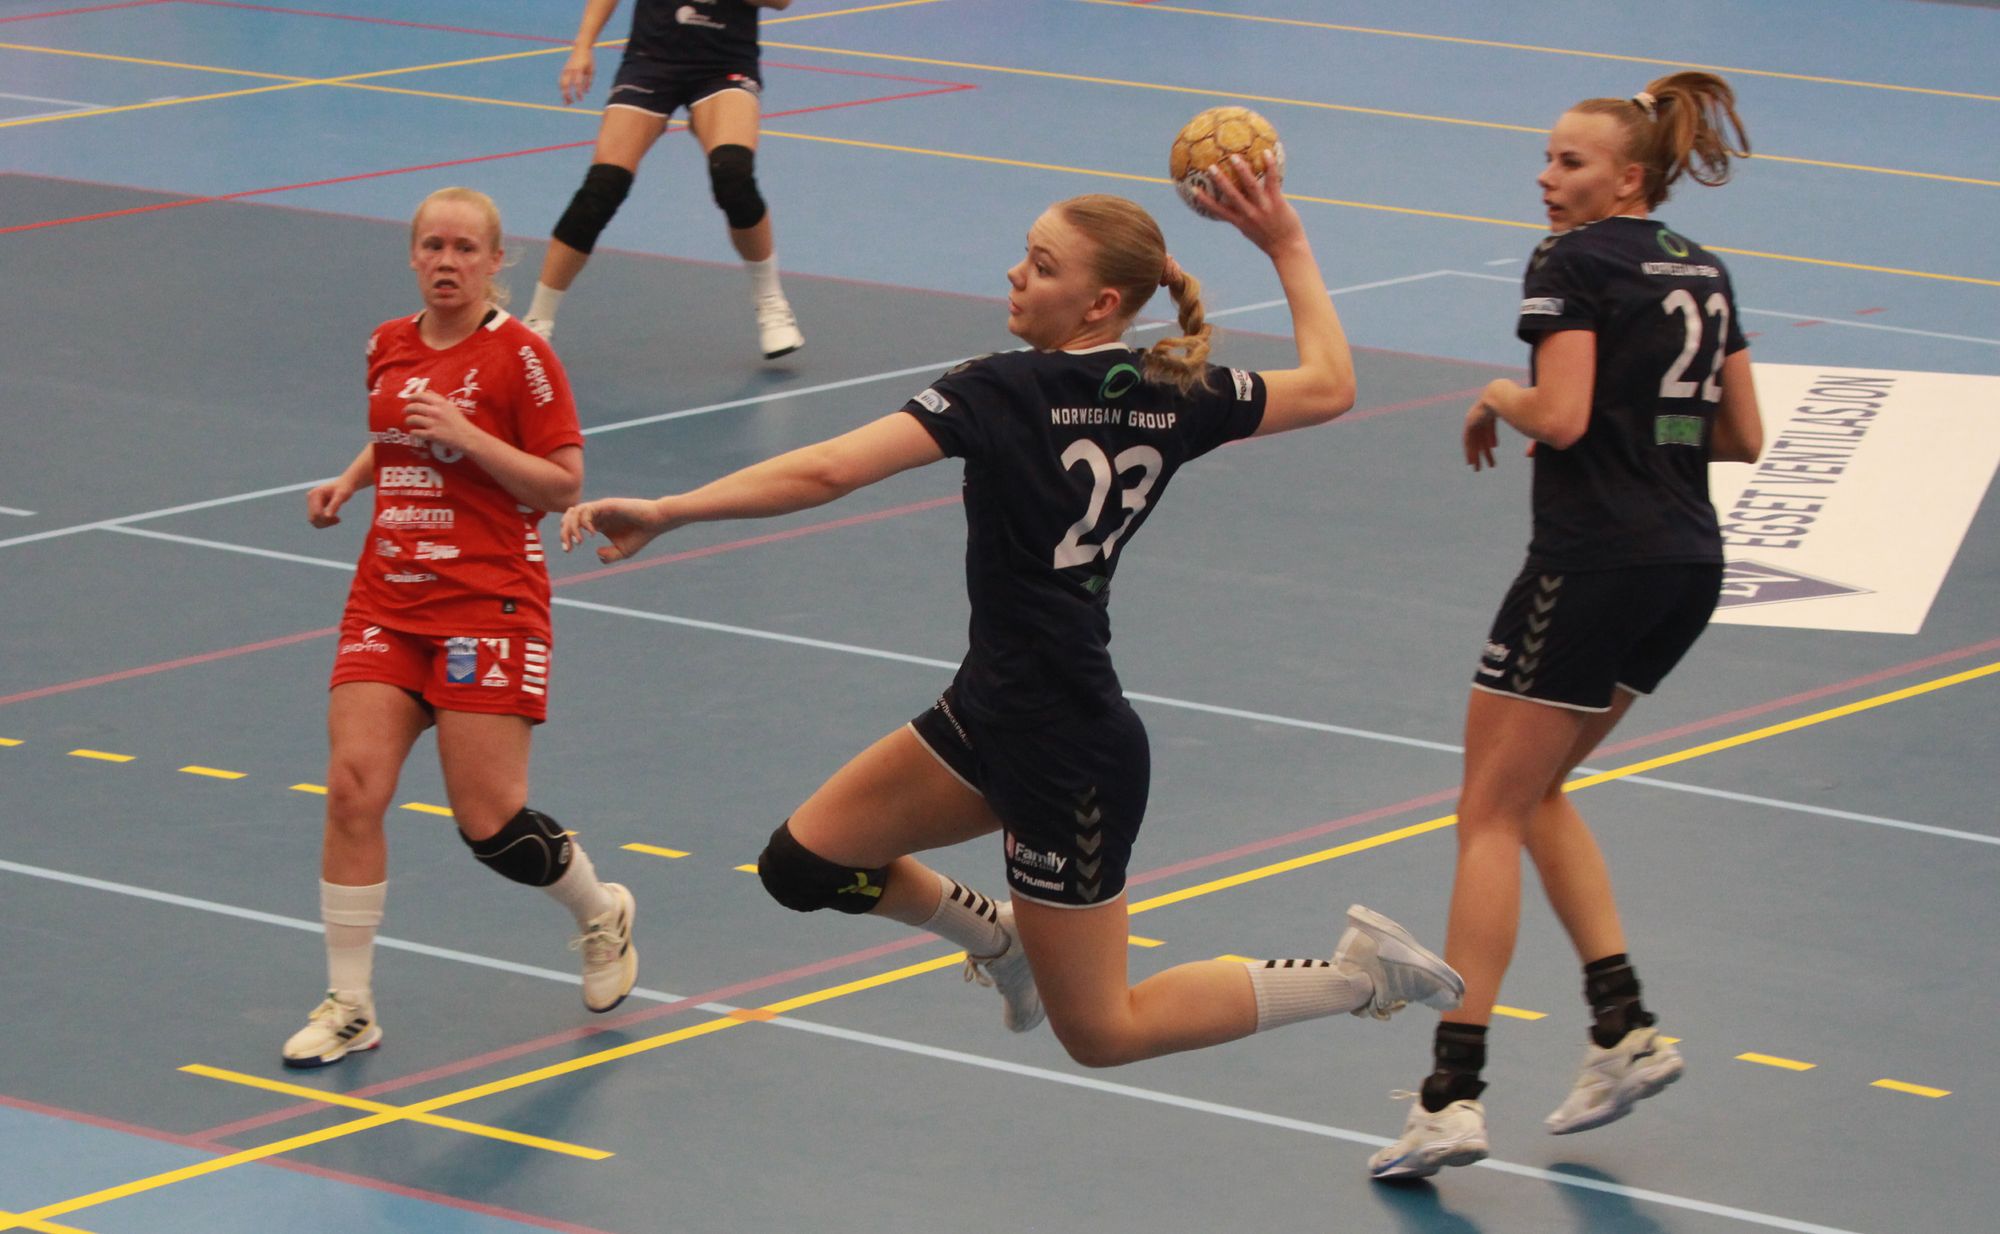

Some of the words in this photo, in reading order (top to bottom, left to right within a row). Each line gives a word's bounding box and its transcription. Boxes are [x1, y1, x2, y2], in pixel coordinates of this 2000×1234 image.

[1657, 289, 1730, 404] 22
[1051, 407, 1122, 425] NORWEGAN
[1128, 410, 1177, 430] GROUP
[1748, 374, 1898, 485] VENTILASJON
[1053, 438, 1164, 570] 23
[1721, 489, 1830, 550] EGSET
[1015, 842, 1068, 874] Family
[1022, 872, 1065, 892] hummel
